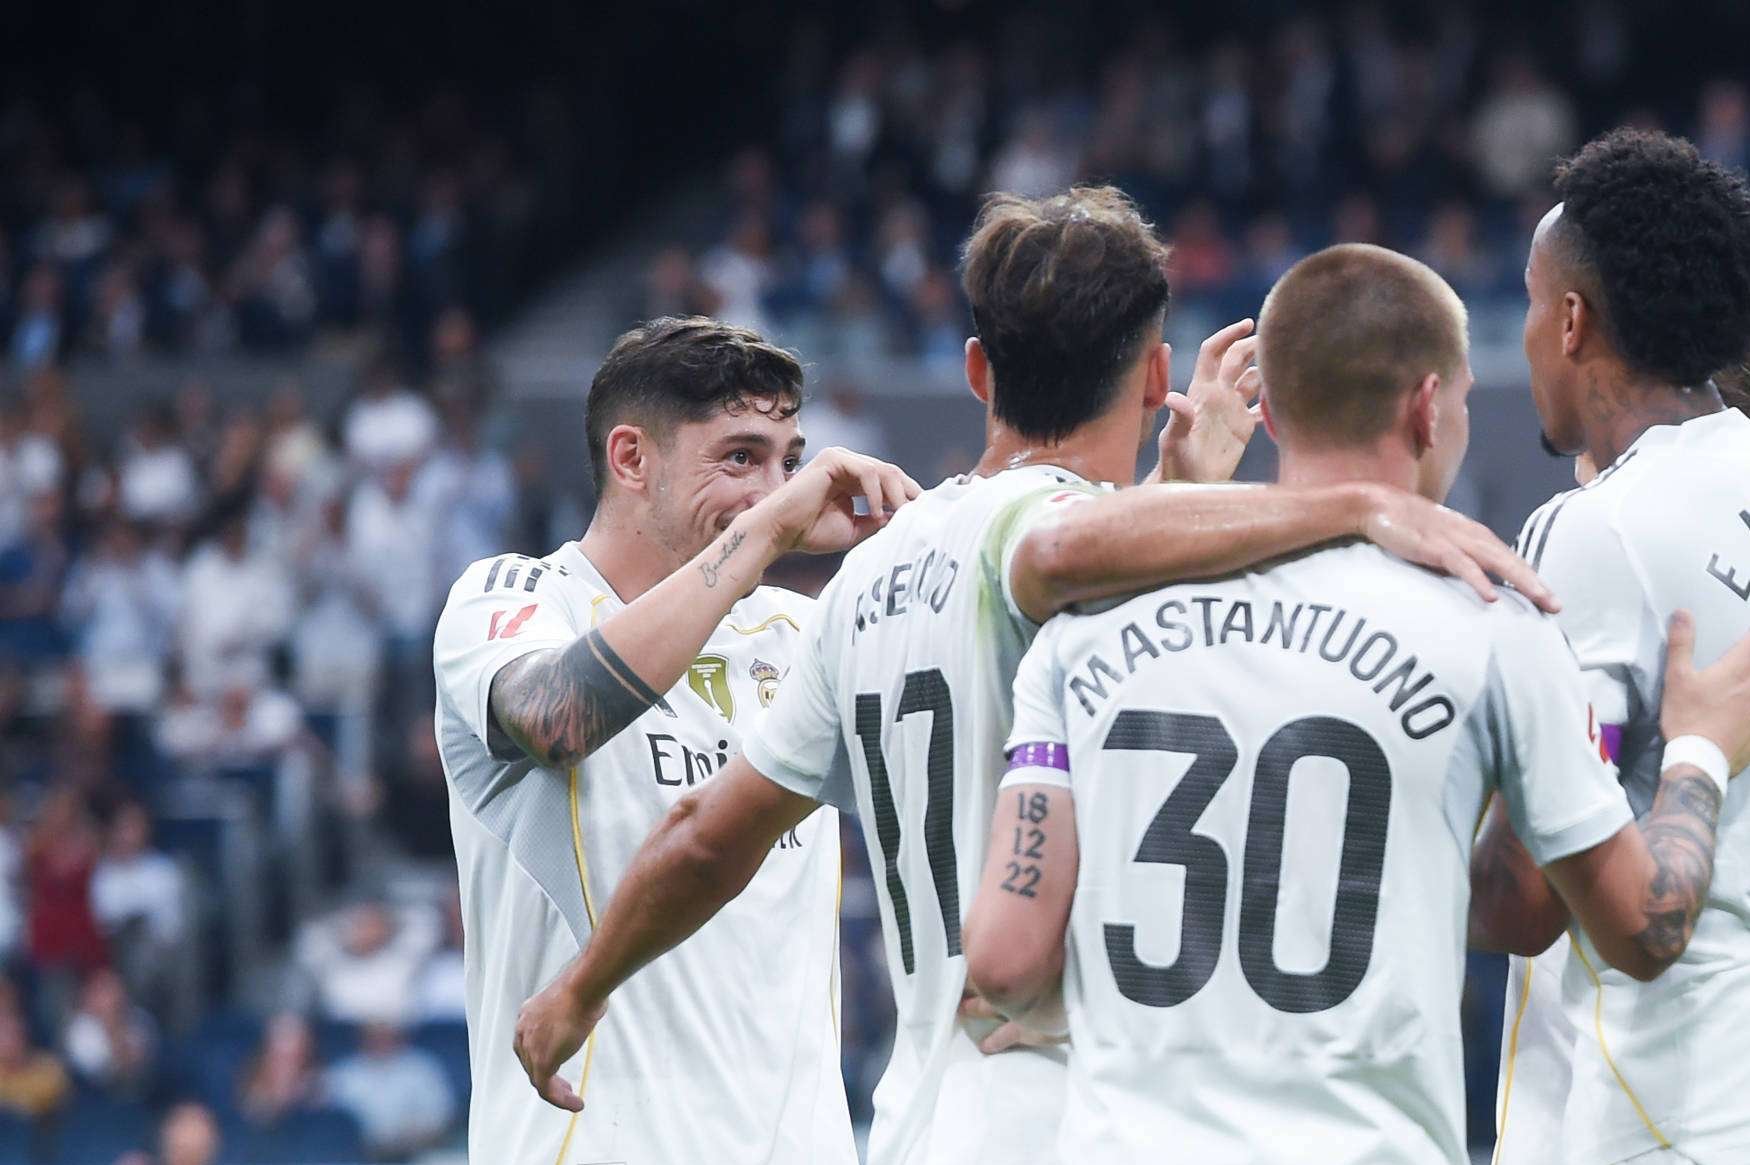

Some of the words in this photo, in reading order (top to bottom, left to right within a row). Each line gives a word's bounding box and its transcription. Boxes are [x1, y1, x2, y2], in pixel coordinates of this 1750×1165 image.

[1068, 597, 1455, 741] MASTANTUONO
[855, 667, 962, 976] 17
[1013, 827, 1046, 859] 12
[1018, 791, 1048, 824] 18
[1001, 861, 1041, 898] 22
[1101, 709, 1394, 1014] 30
